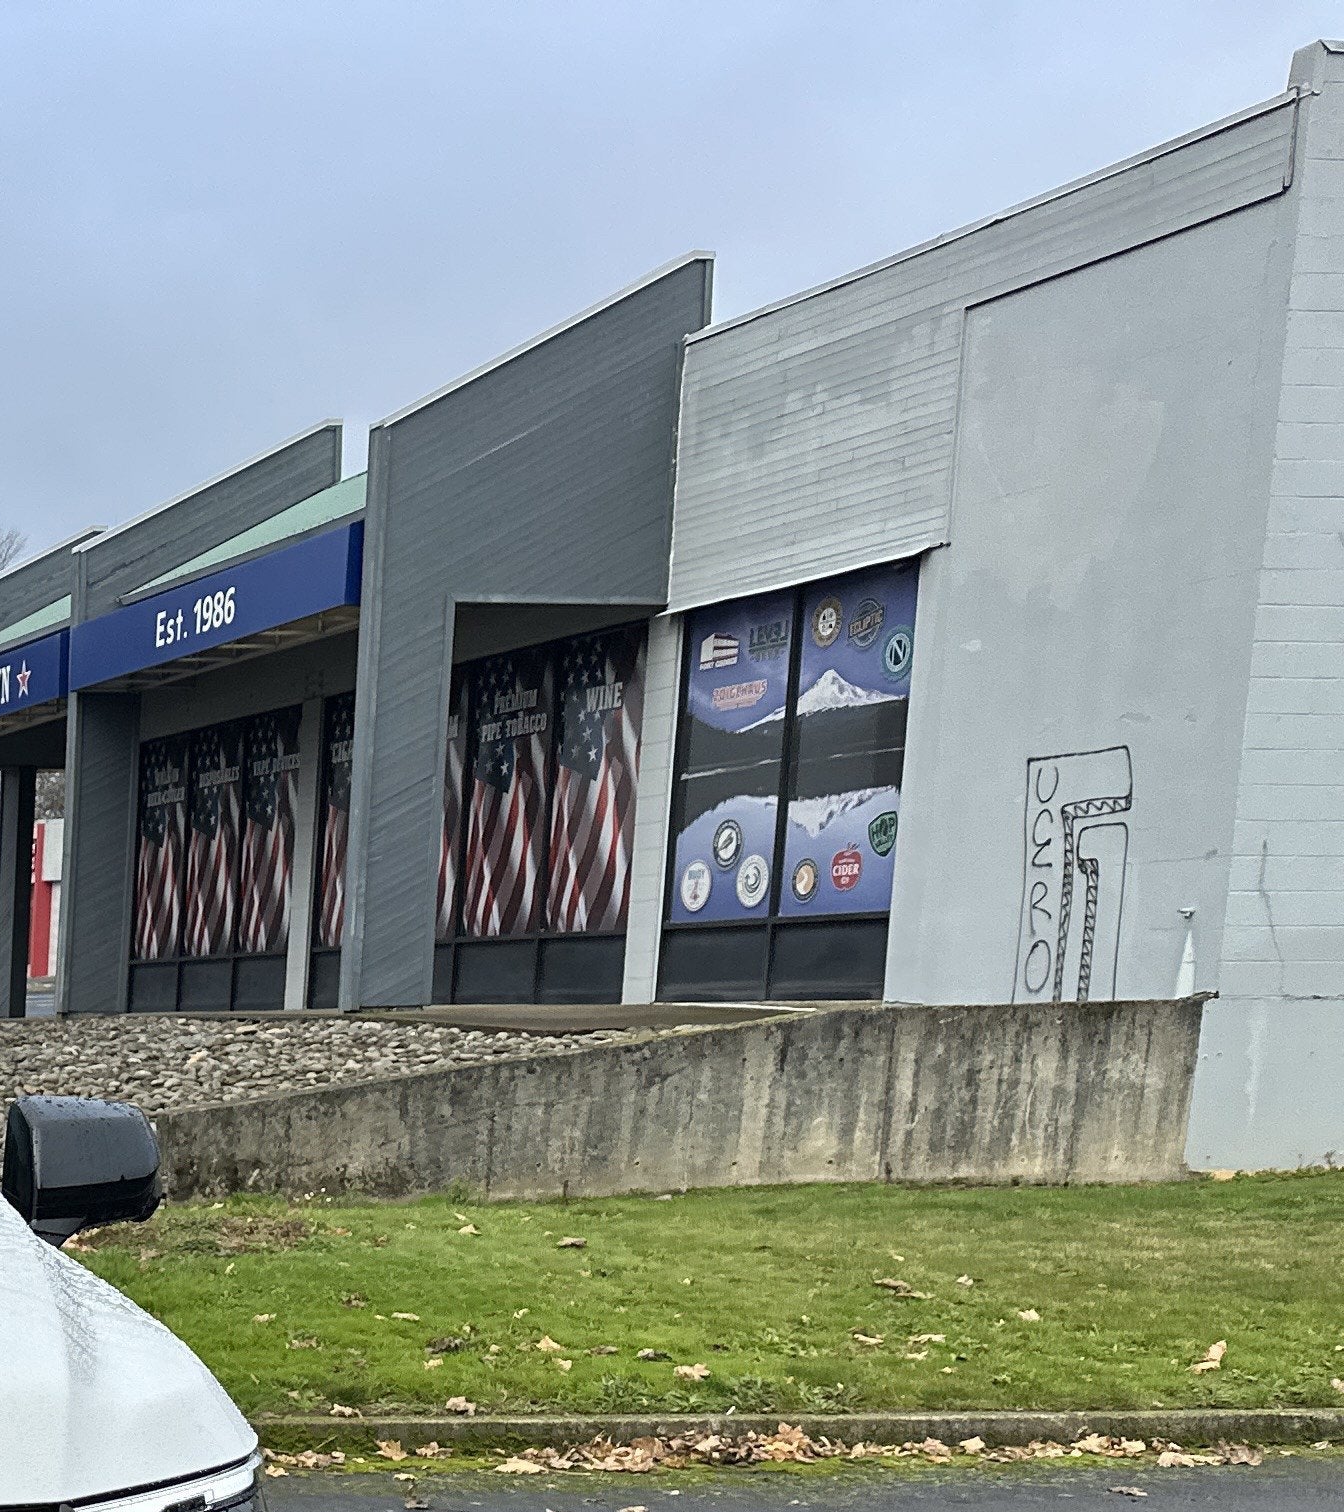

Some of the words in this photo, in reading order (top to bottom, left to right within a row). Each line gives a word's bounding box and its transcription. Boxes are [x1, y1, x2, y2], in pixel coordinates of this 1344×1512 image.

[155, 608, 188, 648] Est.
[193, 586, 236, 634] 1986
[494, 688, 538, 715] PREMIUM
[586, 682, 623, 712] WINE
[480, 722, 503, 743] PIPE
[505, 713, 547, 738] TOBACCO
[833, 864, 859, 877] CIDER
